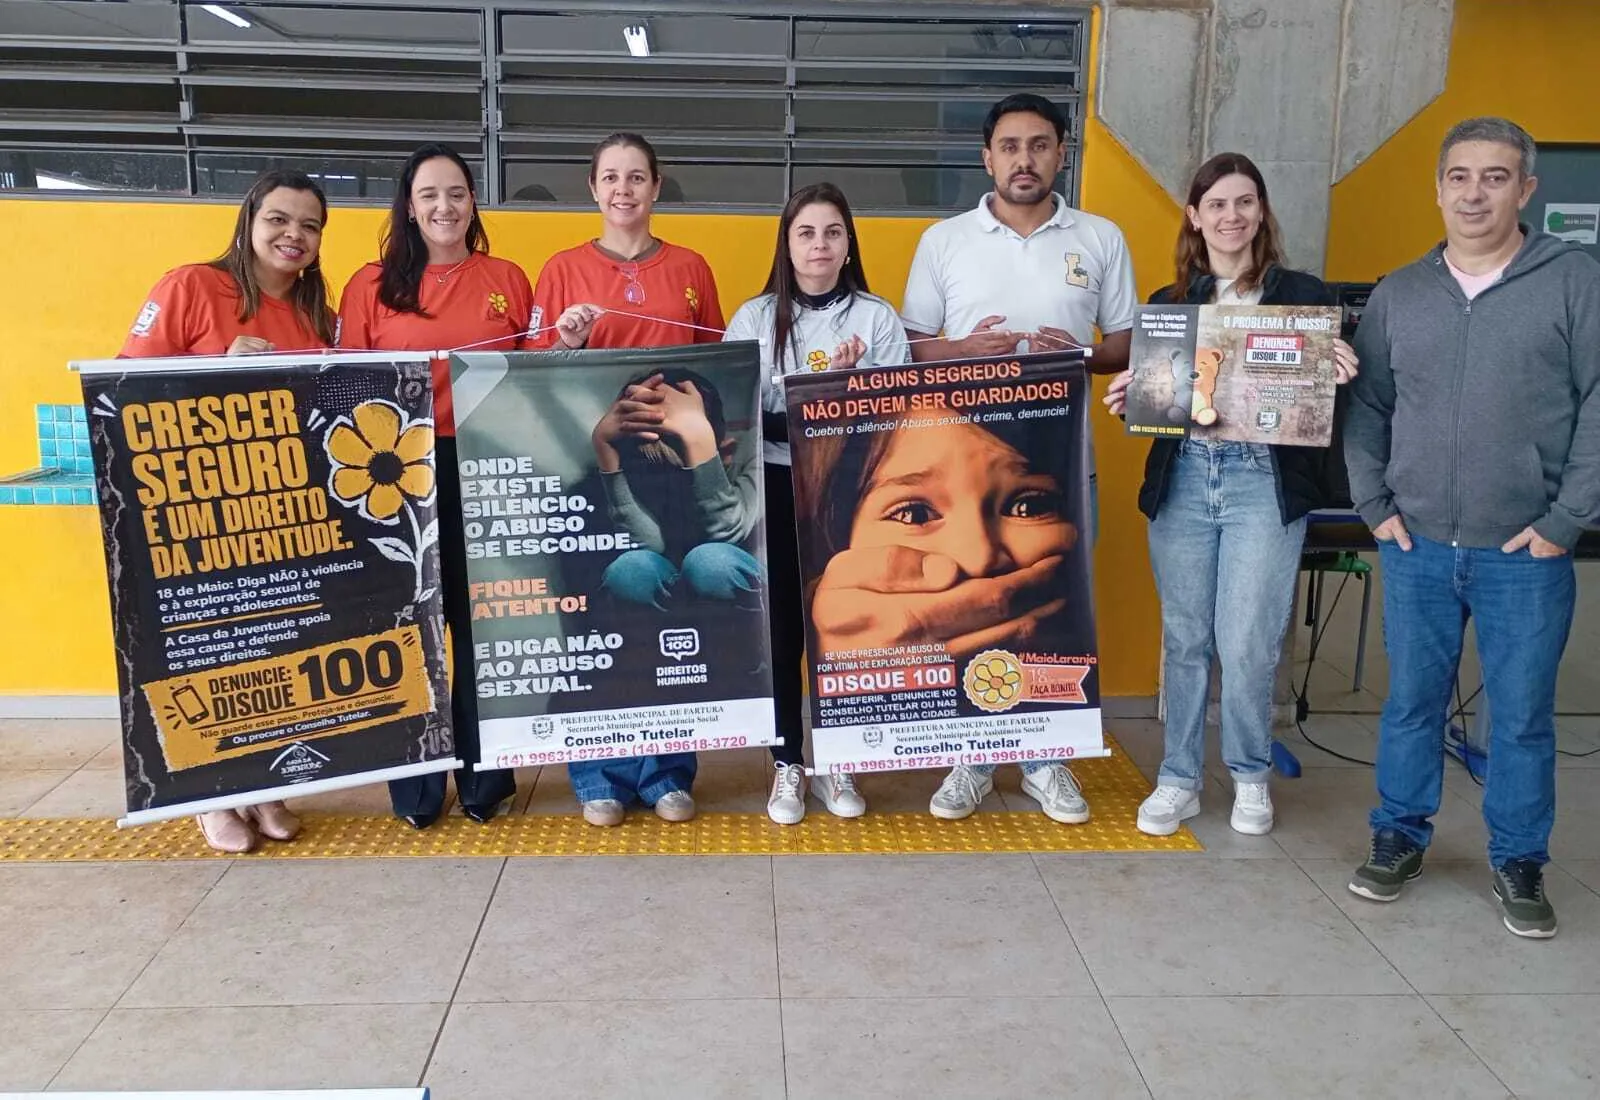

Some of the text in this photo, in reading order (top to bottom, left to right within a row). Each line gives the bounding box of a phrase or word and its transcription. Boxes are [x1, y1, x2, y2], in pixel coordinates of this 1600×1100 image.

[1232, 316, 1283, 329] PROBLEMA
[1253, 336, 1297, 349] DENUNCIE
[1252, 351, 1296, 362] DISQUE 100
[847, 361, 1022, 392] ALGUNS SEGREDOS
[802, 381, 1069, 421] NÃO DEVEM SER GUARDADOS!
[121, 389, 299, 452] CRESCER
[804, 405, 1070, 438] Quebre o silêncio! Abuso sexual é crime, denuncie!
[131, 438, 309, 506] SEGURO
[460, 456, 533, 477] ONDE
[462, 476, 561, 497] EXISTE
[142, 487, 328, 544] É UM DIREITO
[465, 516, 585, 538] O ABUSO
[150, 519, 354, 579] DA JUVENTUDE.
[467, 533, 638, 559] SE ESCONDE.
[156, 559, 364, 600] 18 de Maio: Diga NÃO à violência
[469, 578, 548, 600] FIQUE
[159, 579, 321, 612] e à exploração sexual de
[472, 595, 587, 619] ATENTO!
[161, 591, 320, 625] crianças e adolescentes.
[165, 612, 331, 647] A Casa da Juventude apoia
[166, 630, 299, 659] essa causa e defende
[474, 629, 624, 660] E DIGA NÃO
[666, 641, 693, 650] 100
[825, 652, 834, 660] SE
[858, 647, 905, 658] PRESENCIAR
[906, 644, 932, 654] ABUSO
[934, 643, 945, 652] OU
[168, 647, 271, 671] os seus direitos.
[476, 653, 613, 679] AO ABUSO
[817, 664, 833, 673] FOR
[860, 661, 870, 669] DE
[871, 656, 922, 668] EXPLORAÇÃO
[1018, 652, 1097, 664] #MaioLaranja
[208, 666, 293, 696] DENUNCIE:
[298, 640, 403, 702] 100
[656, 664, 707, 677] DIREITOS
[656, 675, 707, 686] HUMANOS
[822, 668, 951, 693] DISQUE 100
[478, 675, 592, 699] SEXUAL.
[820, 699, 832, 707] SE
[892, 691, 940, 701] DENUNCIE
[942, 689, 957, 697] NO
[211, 683, 296, 722] DISQUE
[820, 699, 957, 717] CONSELHO TUTELAR OU NAS
[232, 736, 247, 744] Ou
[249, 728, 285, 743] procure
[295, 718, 336, 731] Conselho
[338, 710, 372, 722] Tutelar.
[561, 705, 724, 725] PREFEITURA MUNICIPAL DE FARTURA
[567, 723, 604, 734] Secretaria
[606, 718, 644, 731] Municipal
[645, 719, 654, 727] de
[697, 715, 719, 723] Social
[821, 709, 959, 727] DELEGACIAS DA SUA CIDADE.
[889, 724, 944, 734] PREFEITURA
[945, 721, 994, 730] MUNICIPAL
[1010, 716, 1051, 725] FARTURA
[200, 730, 219, 739] Não
[221, 723, 253, 736] guarde
[256, 719, 275, 728] esse
[564, 728, 694, 747] Conselho Tutelar
[895, 734, 933, 743] Secretaria
[934, 730, 971, 740] Municipal
[496, 735, 747, 768] (14) 99631-8722 e (14) 99618-3720
[894, 738, 1021, 755] Conselho Tutelar
[829, 746, 1074, 774] (14) 99631-8722 e (14) 99618-3720
